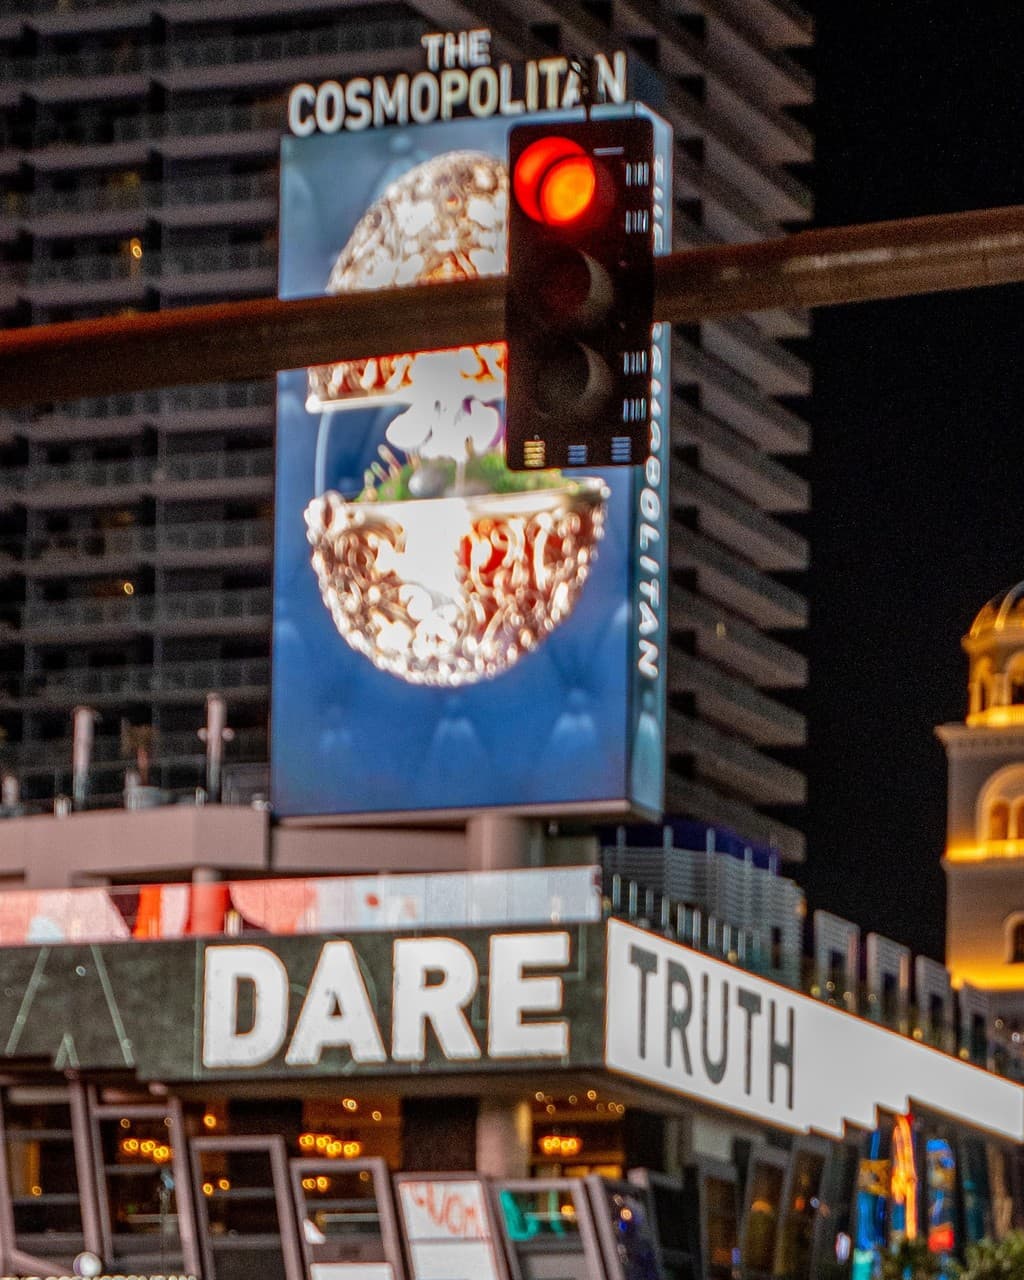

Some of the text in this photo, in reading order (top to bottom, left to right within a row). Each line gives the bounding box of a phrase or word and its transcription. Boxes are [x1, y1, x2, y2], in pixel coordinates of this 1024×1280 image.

[288, 51, 628, 137] COSMOPOLITAN
[421, 28, 492, 71] THE
[202, 932, 571, 1069] DARE
[628, 943, 796, 1110] TRUTH
